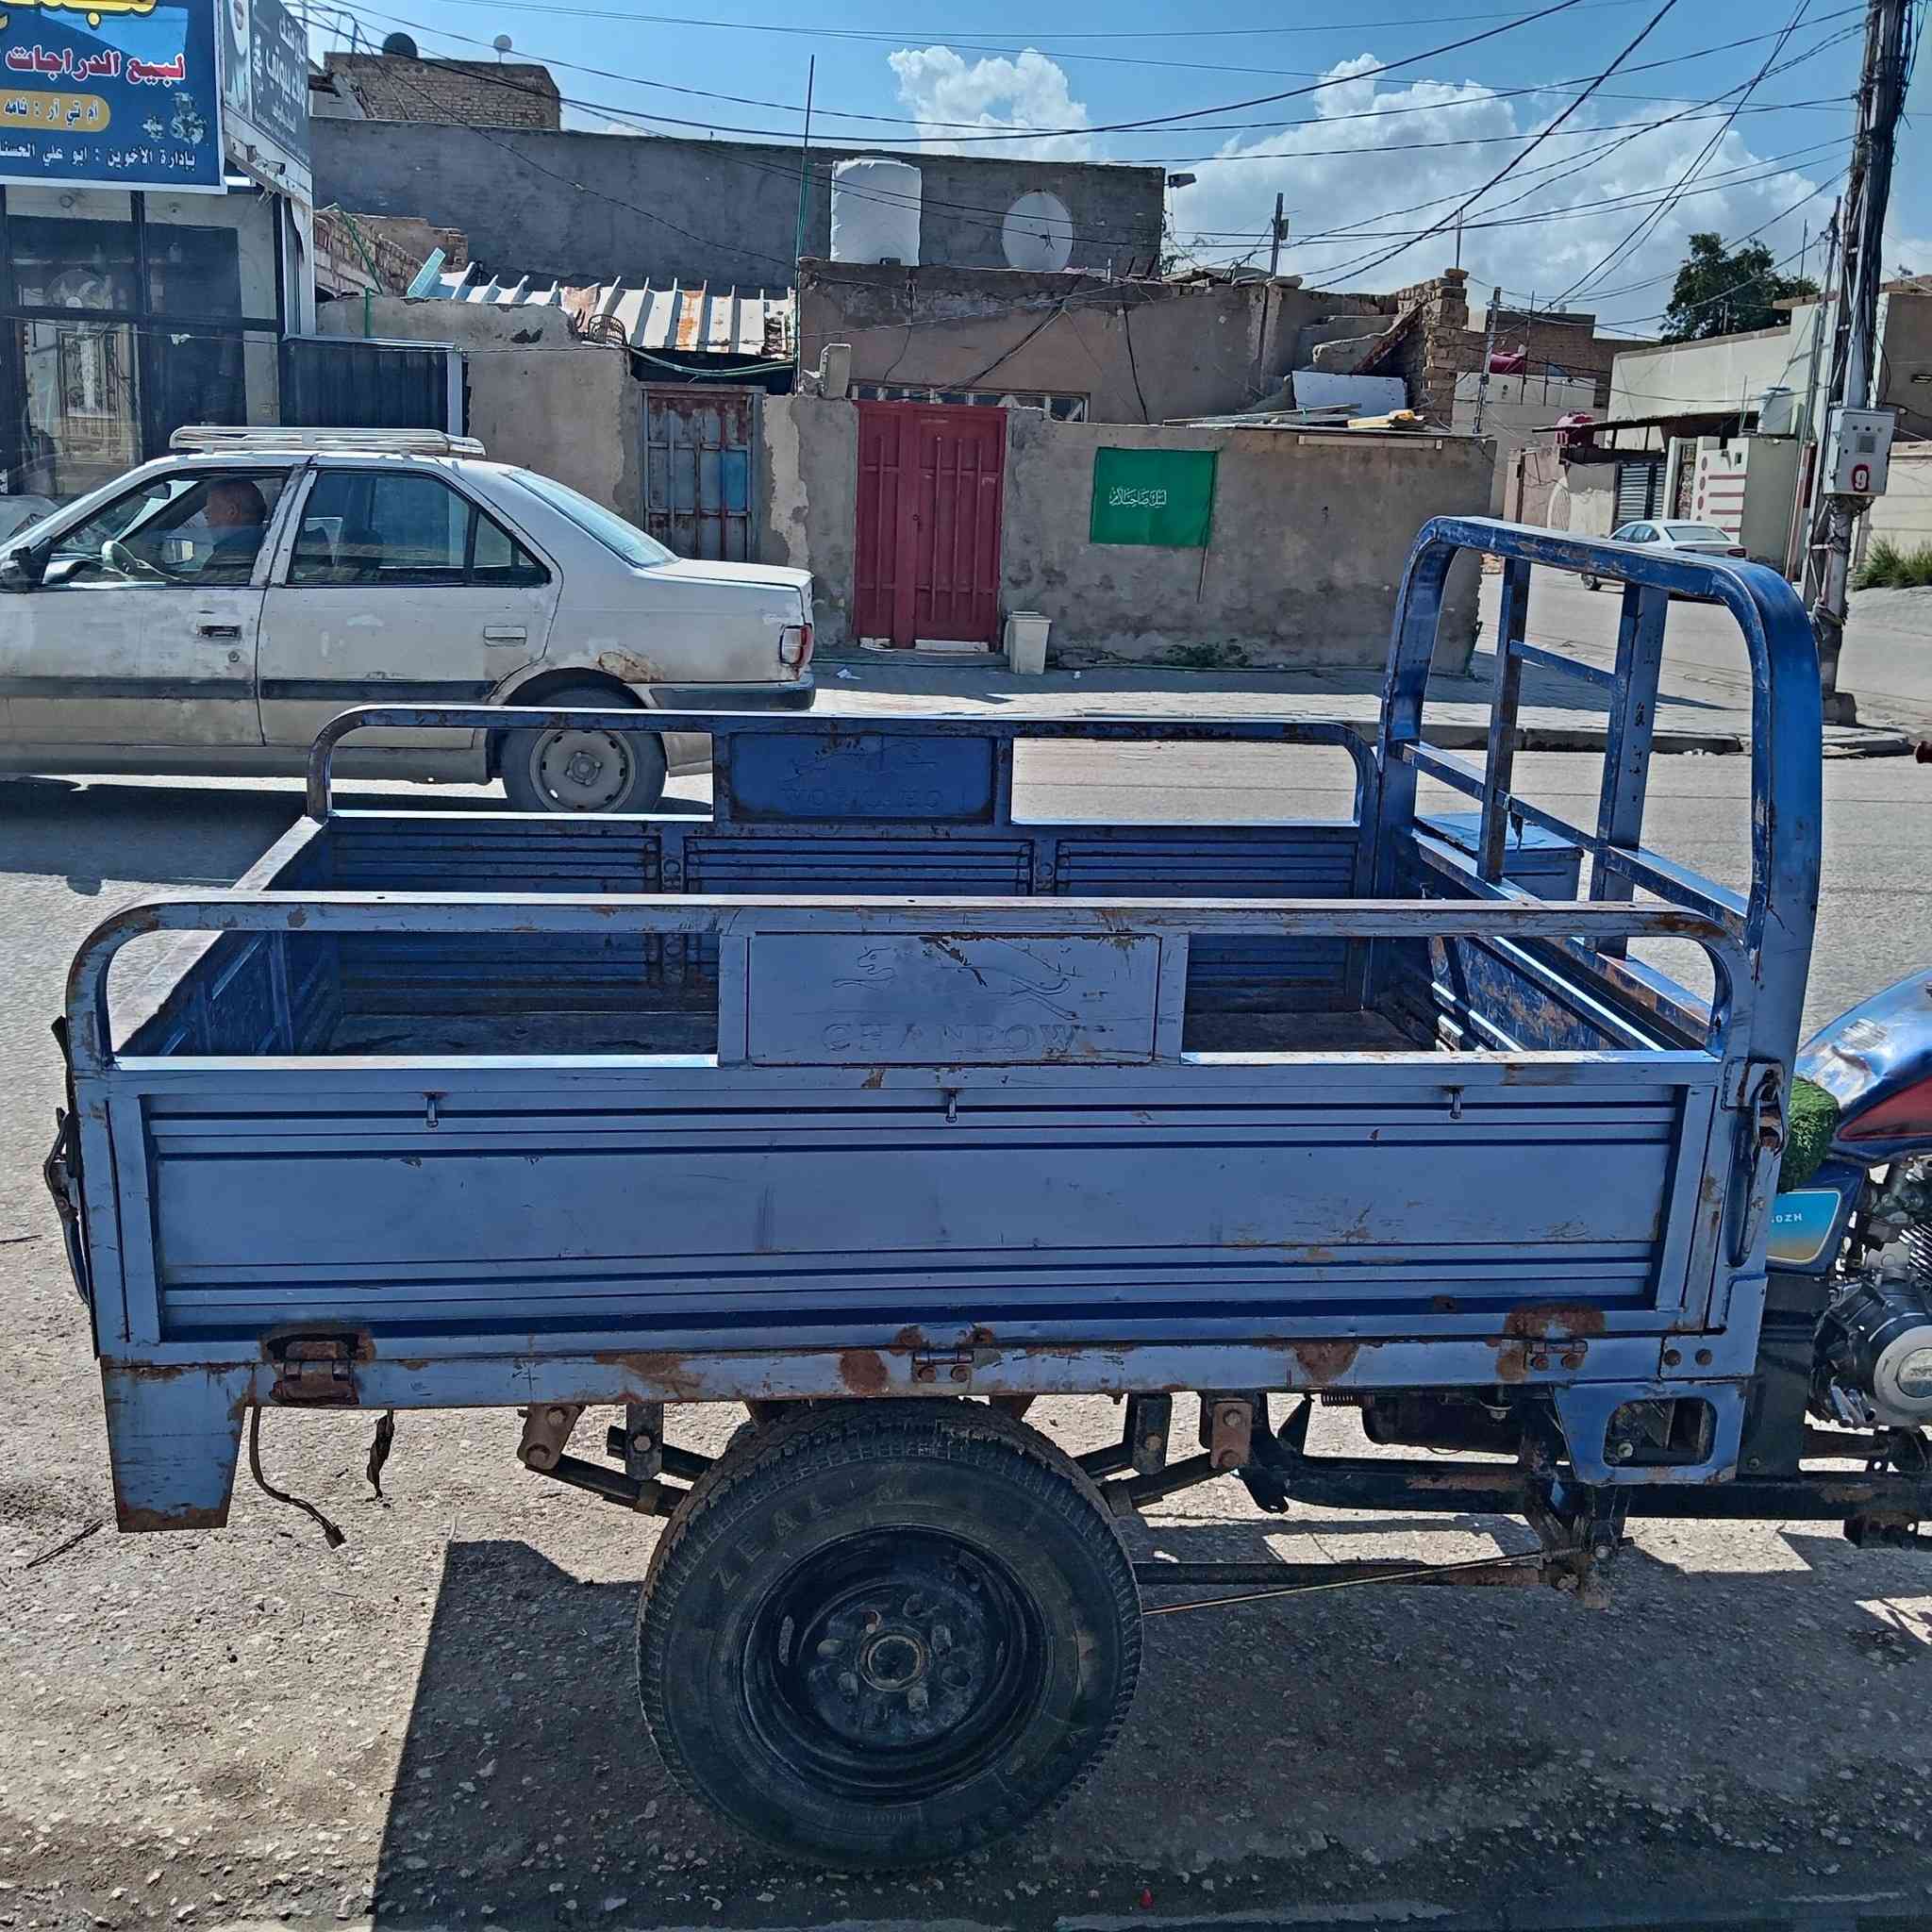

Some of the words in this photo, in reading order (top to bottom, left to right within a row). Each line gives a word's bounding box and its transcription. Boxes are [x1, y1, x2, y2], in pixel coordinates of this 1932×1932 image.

[6, 45, 122, 82] الدراجات
[126, 53, 186, 88] لبيع
[42, 143, 63, 167] علي
